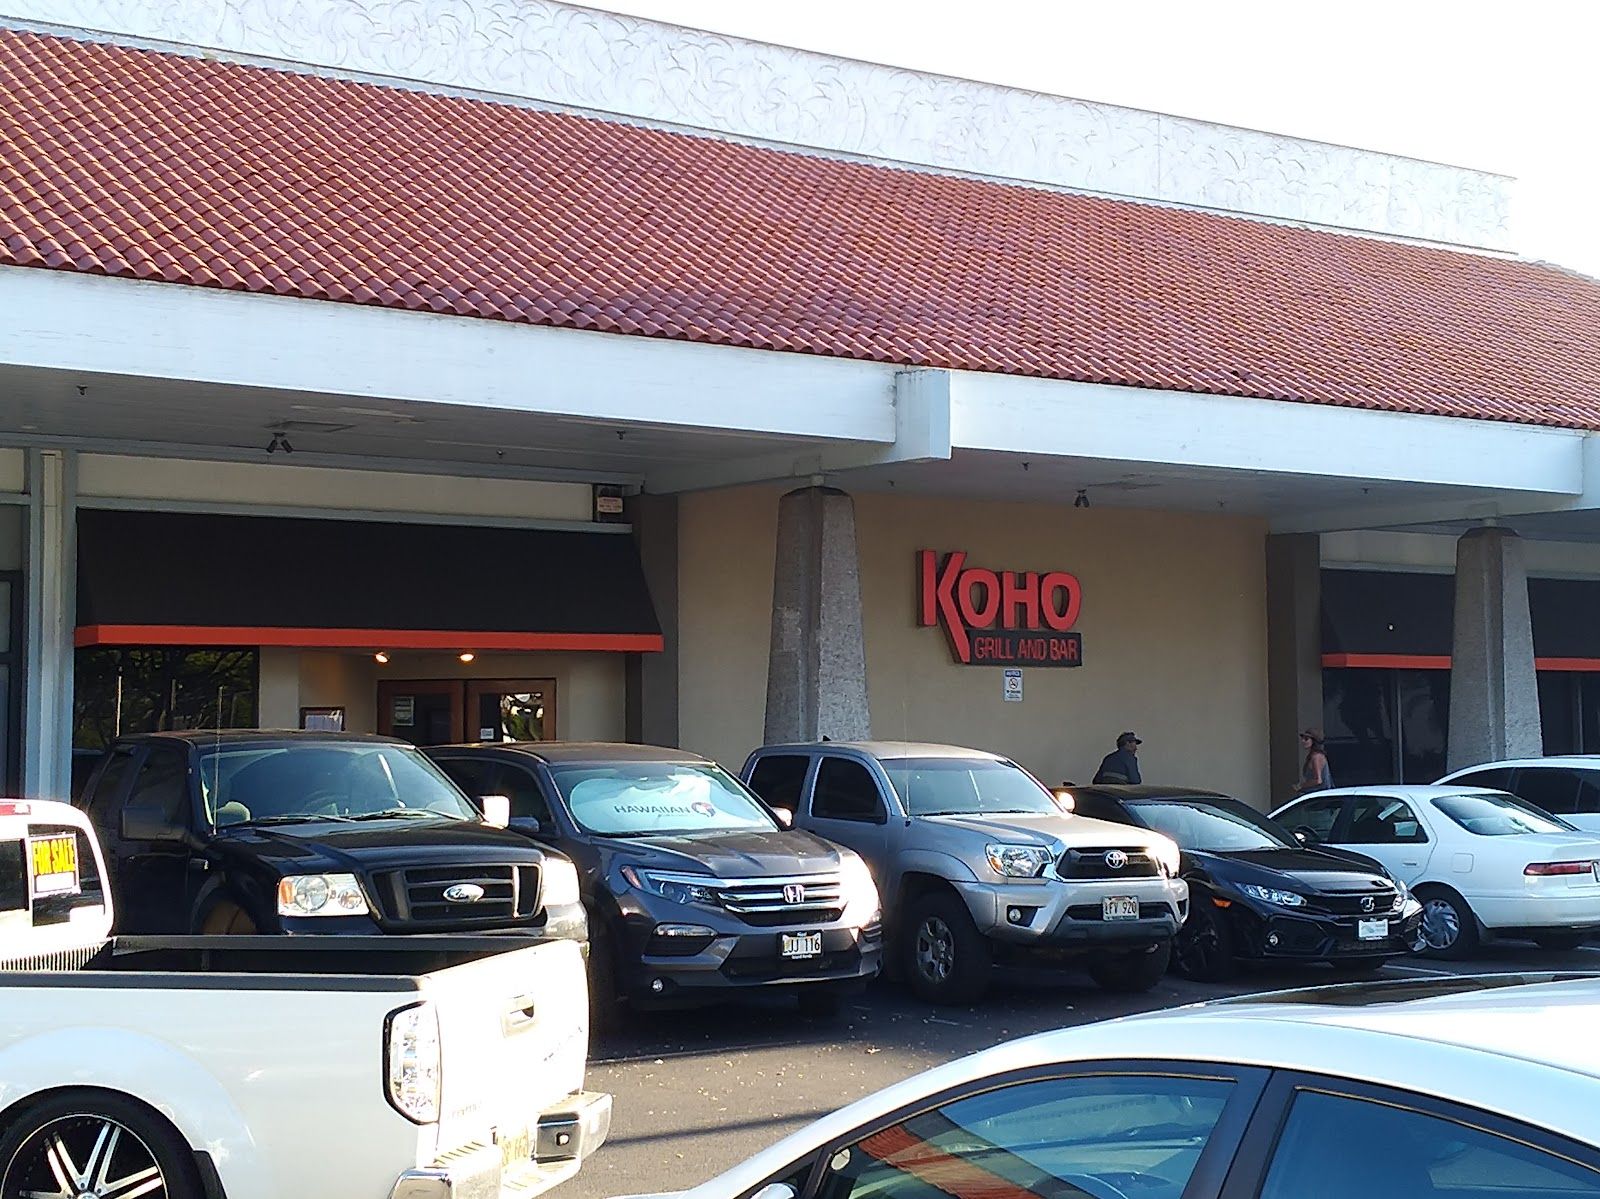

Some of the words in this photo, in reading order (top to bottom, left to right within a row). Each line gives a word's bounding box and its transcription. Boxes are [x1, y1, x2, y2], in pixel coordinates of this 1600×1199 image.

[922, 550, 1081, 662] KOHO
[975, 637, 1014, 659] GRILL
[1018, 638, 1047, 660] AND
[1050, 639, 1078, 661] BAR
[614, 805, 691, 814] HAWAIIAN
[33, 841, 52, 875] FOR
[51, 838, 76, 873] SALE
[1122, 901, 1136, 914] 920
[805, 938, 820, 951] 116
